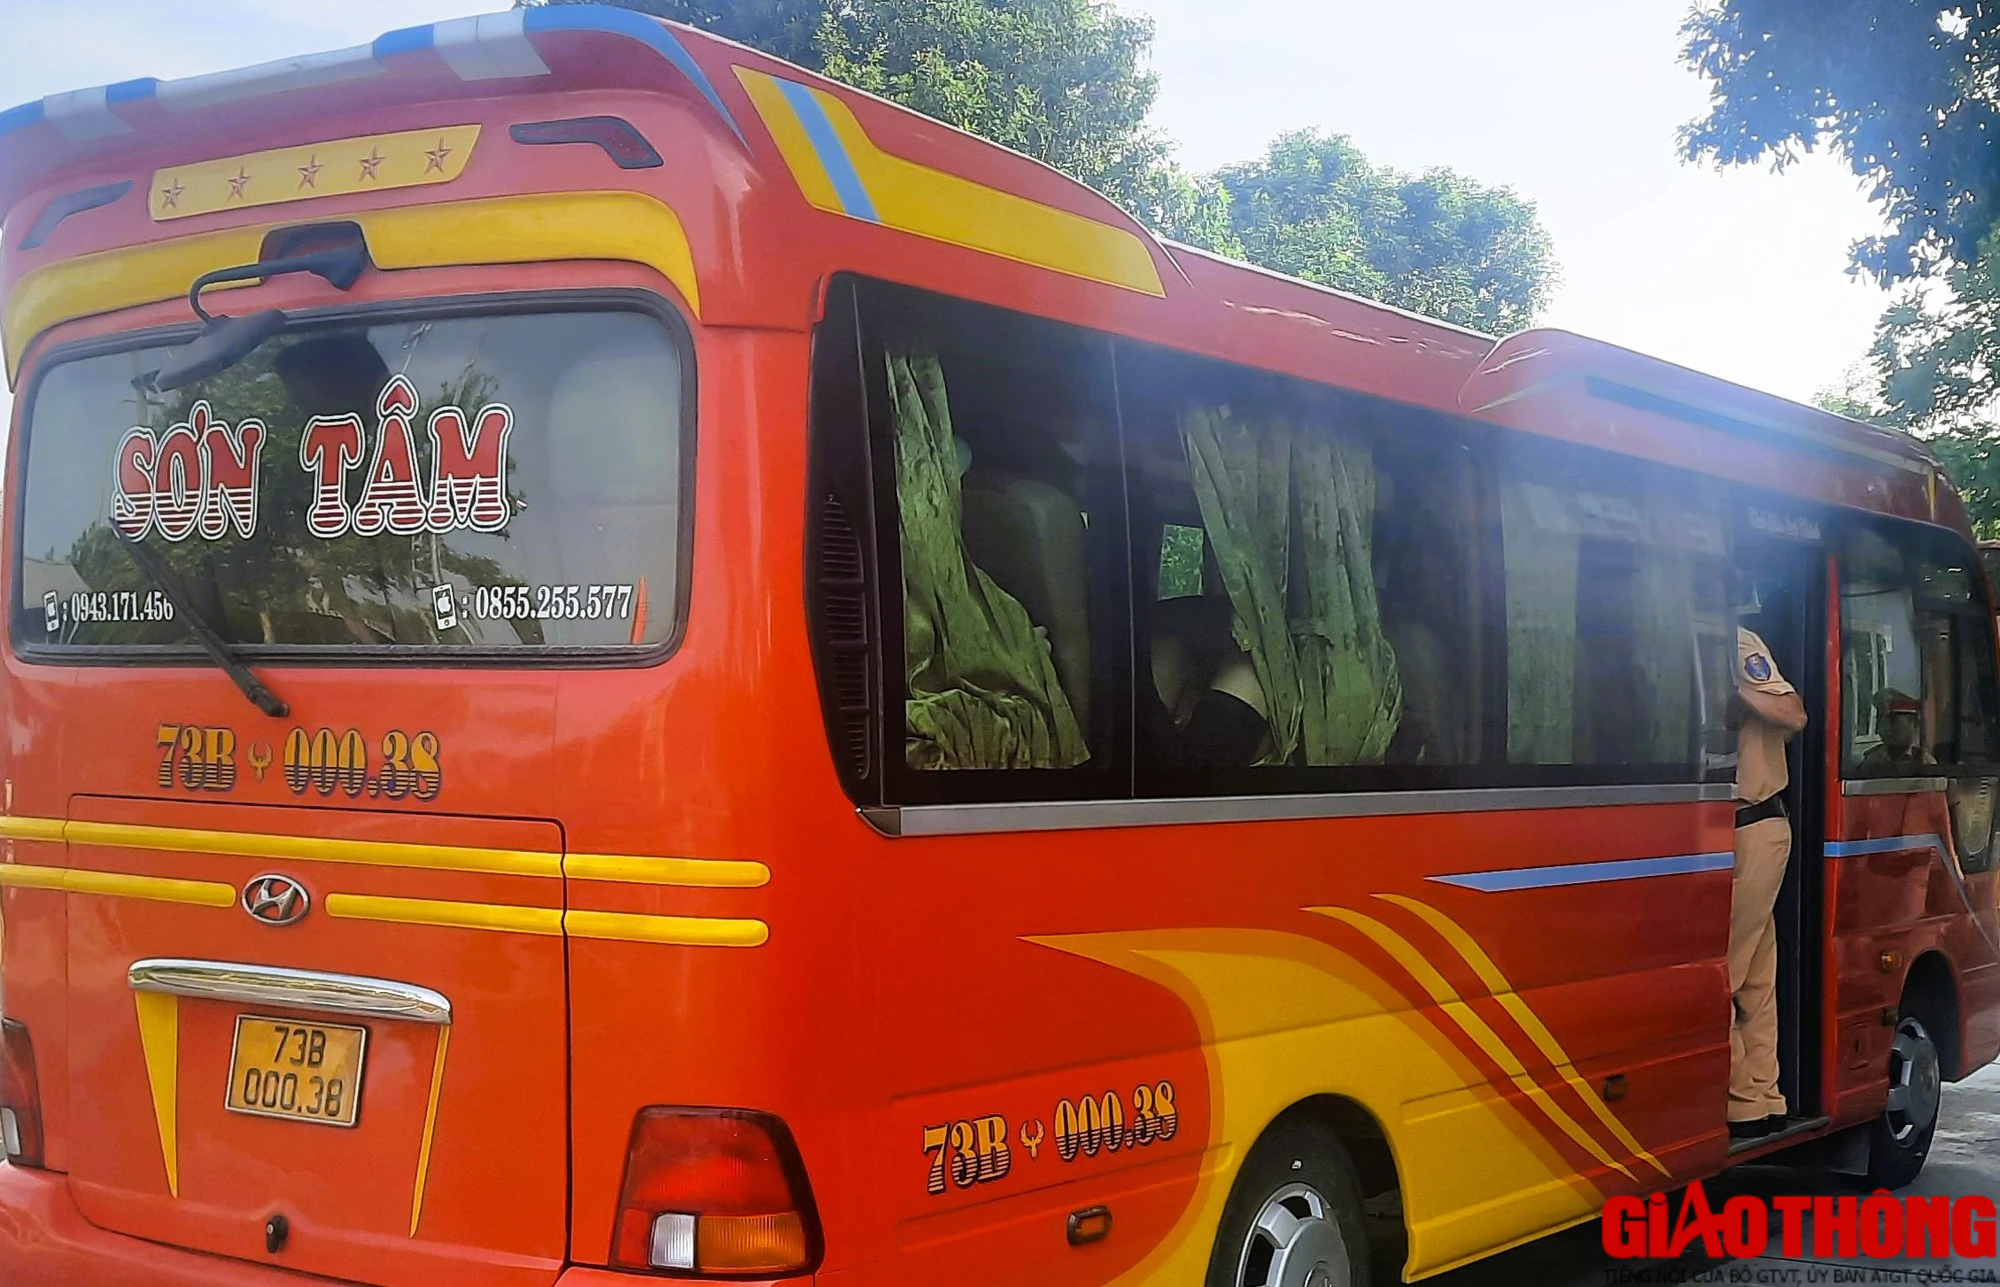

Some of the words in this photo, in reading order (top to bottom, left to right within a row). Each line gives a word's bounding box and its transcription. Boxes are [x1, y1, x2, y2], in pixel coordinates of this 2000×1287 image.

[110, 400, 265, 542] SƠN
[298, 373, 514, 539] TÂM
[156, 723, 237, 791] 73B
[282, 726, 442, 801] 000.38
[273, 1026, 327, 1069] 73B
[243, 1067, 344, 1117] 000.38
[923, 1114, 1012, 1196] 73B
[1054, 1080, 1178, 1162] 000.38
